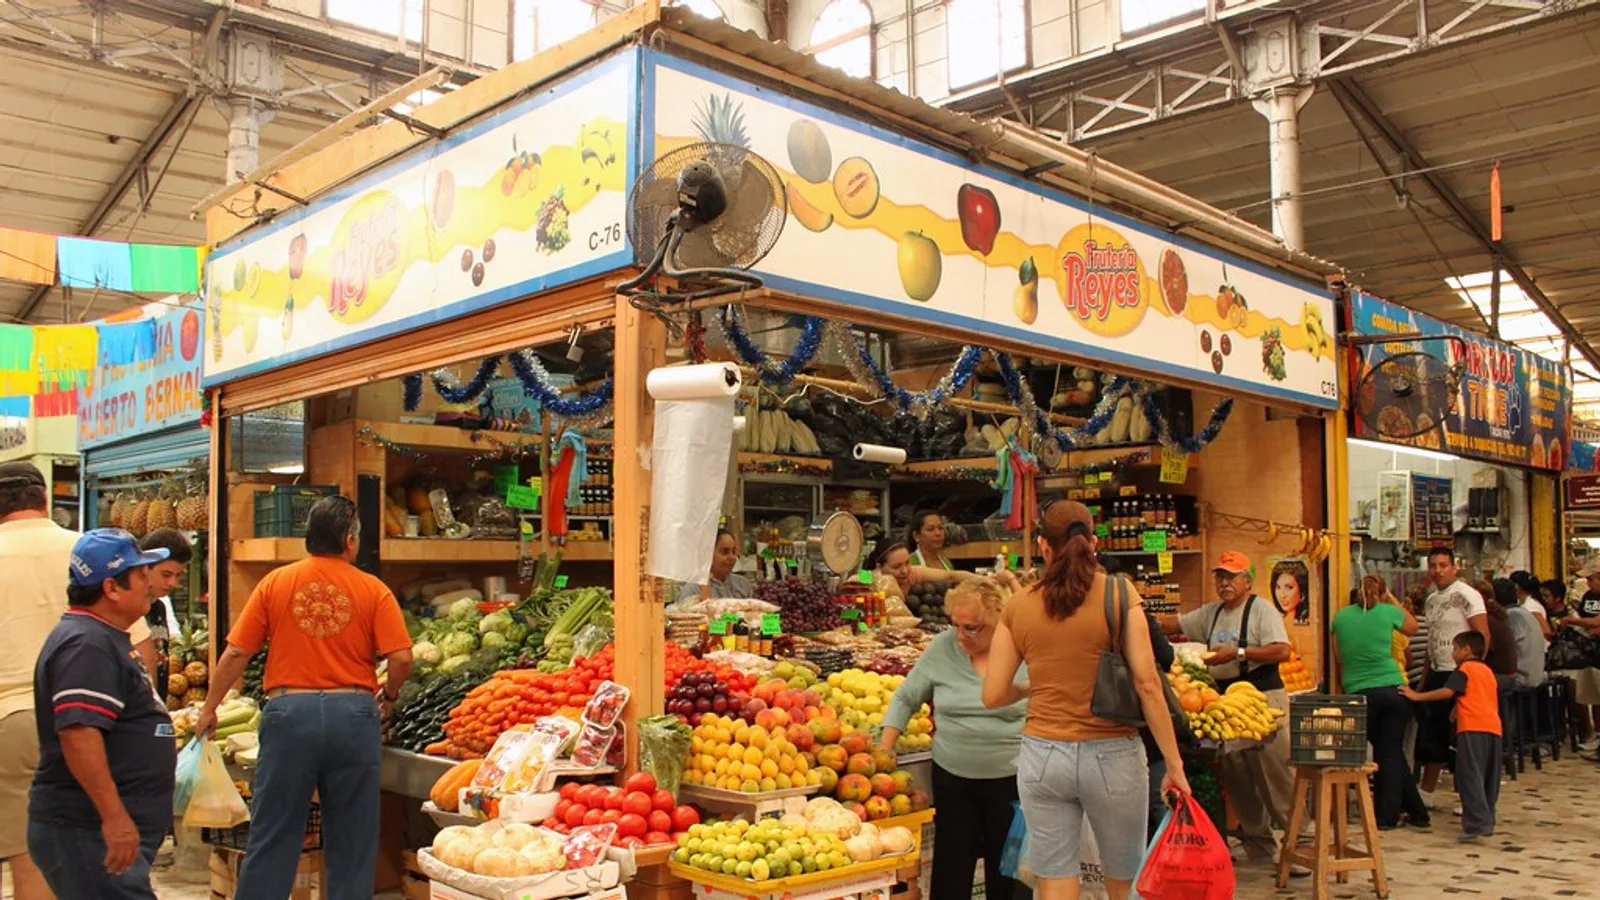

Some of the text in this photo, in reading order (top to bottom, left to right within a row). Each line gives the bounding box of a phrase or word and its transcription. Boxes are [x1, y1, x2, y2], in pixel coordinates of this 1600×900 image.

[588, 222, 621, 251] C-76
[1084, 239, 1137, 271] Frutería
[1063, 252, 1140, 321] Reyes
[144, 366, 202, 423] BERNAL
[1320, 380, 1336, 397] C76
